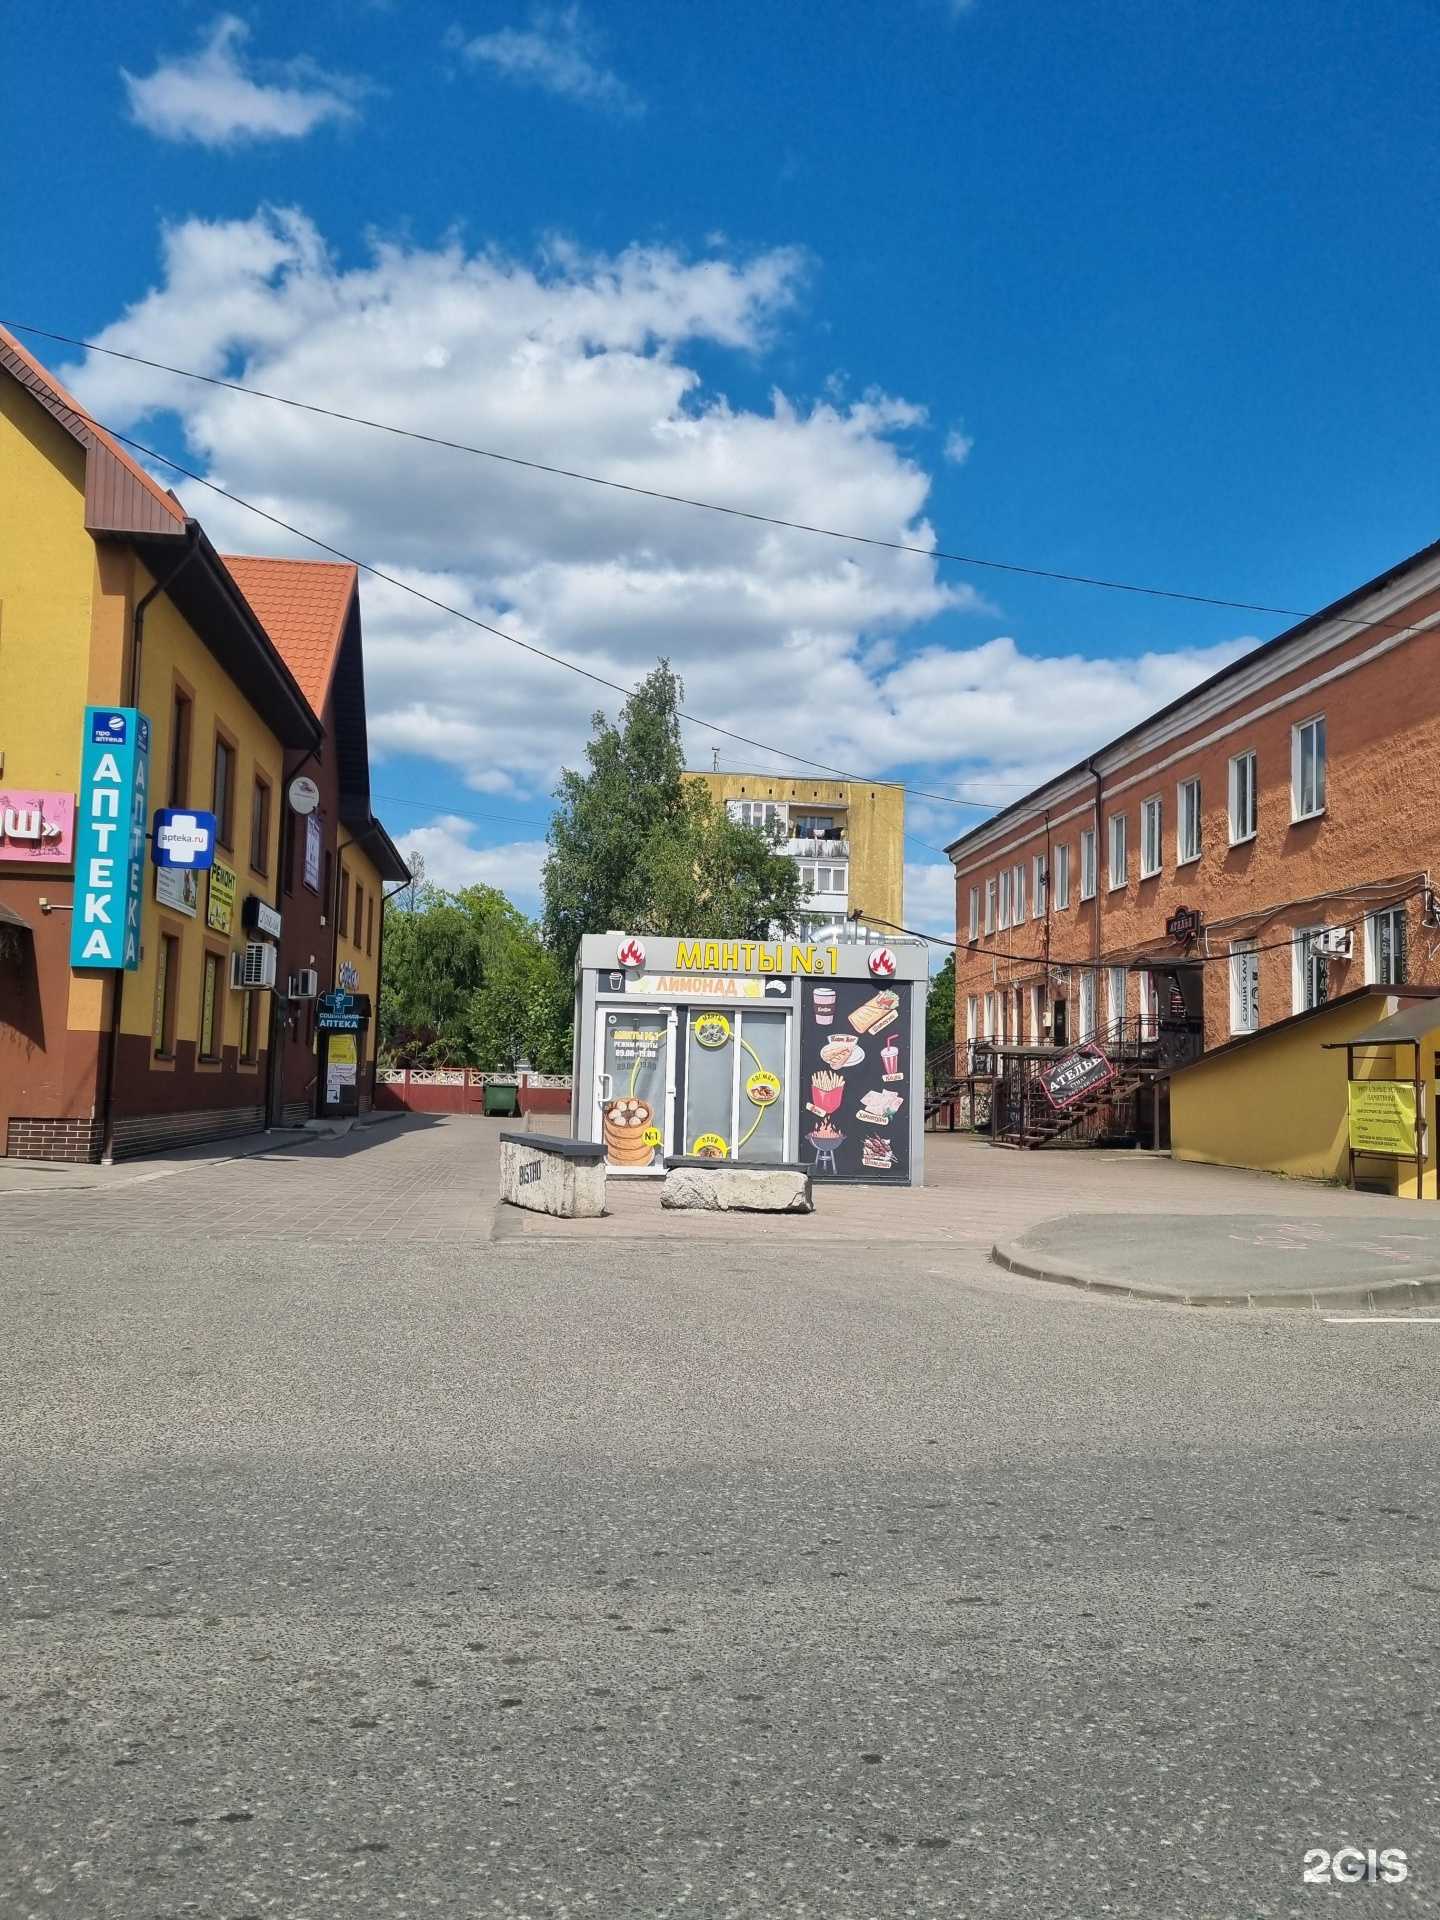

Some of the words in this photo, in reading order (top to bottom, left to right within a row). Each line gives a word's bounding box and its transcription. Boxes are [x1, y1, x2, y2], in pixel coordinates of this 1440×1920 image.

[161, 833, 204, 844] apteka.ru
[82, 753, 122, 959] АПТЕКА
[126, 759, 145, 962] АПТЕКА
[676, 941, 783, 973] МАНТЫ
[656, 975, 737, 997] ЛИМОНАД
[319, 1019, 358, 1029] АПТЕКА
